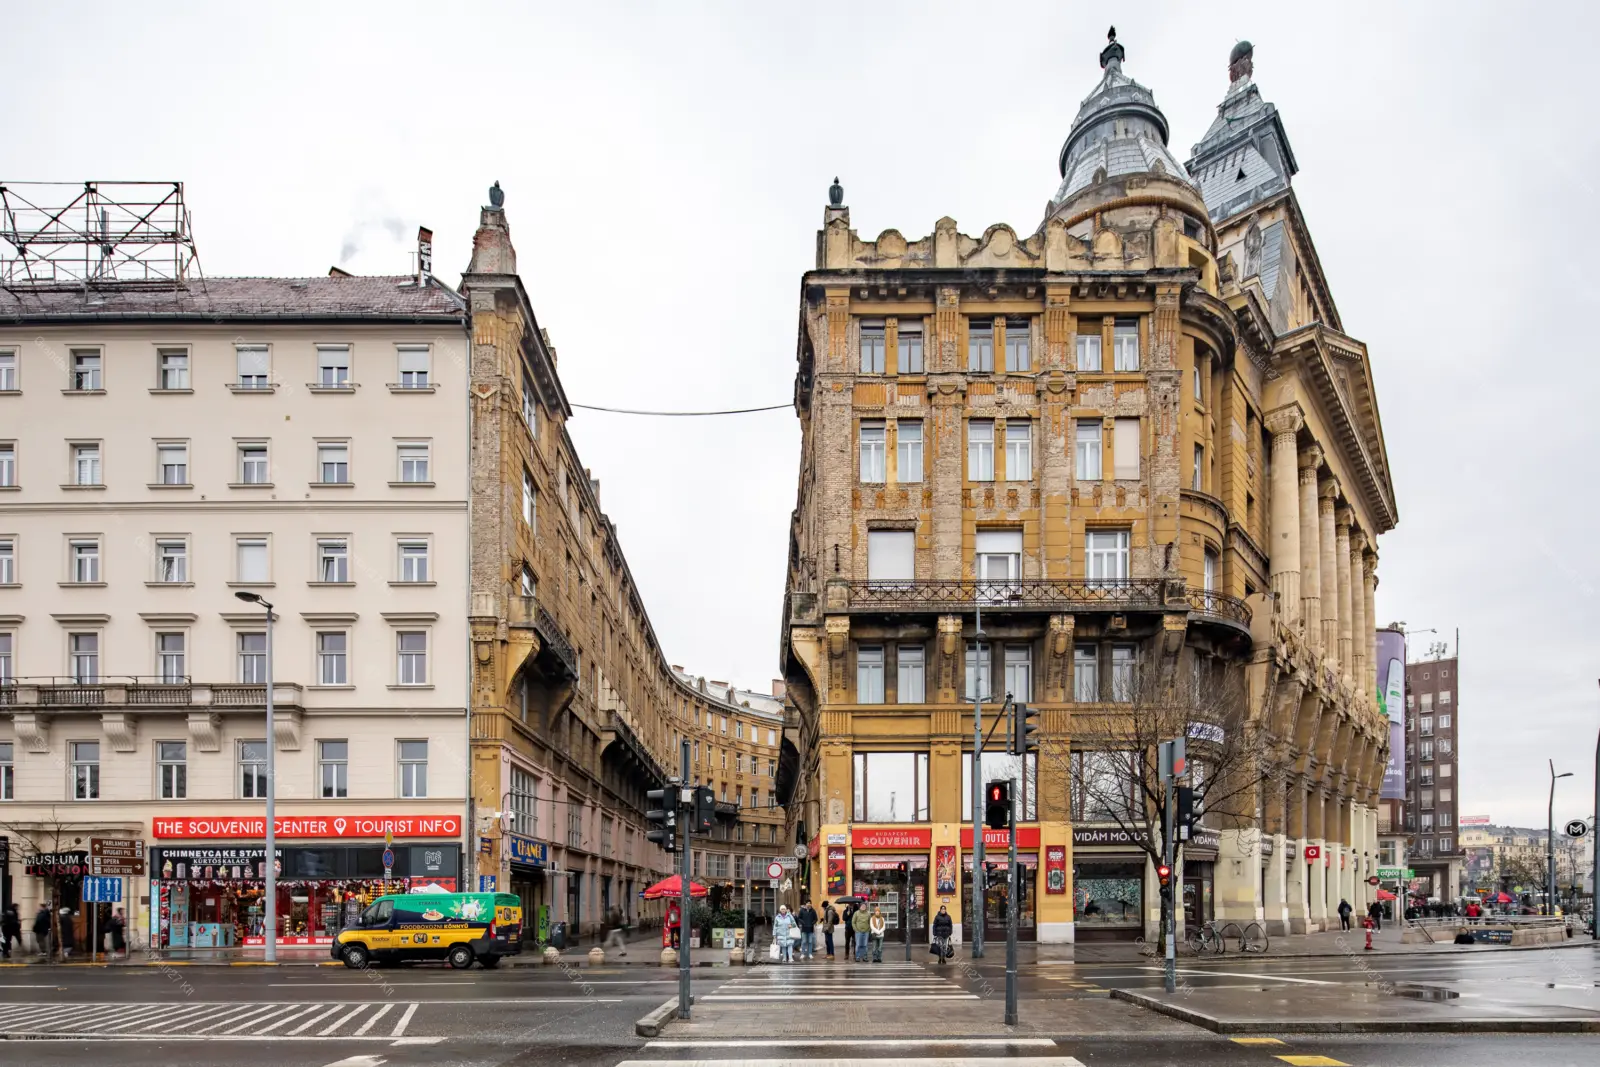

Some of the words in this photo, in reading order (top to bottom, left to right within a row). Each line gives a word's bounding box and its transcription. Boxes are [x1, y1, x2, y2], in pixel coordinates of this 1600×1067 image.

[156, 821, 183, 834] THE
[189, 821, 264, 834] SOUVENIR
[273, 821, 327, 834] CENTER
[354, 820, 413, 833] TOURIST
[419, 820, 457, 833] INFO
[1569, 823, 1583, 835] M
[862, 837, 921, 846] SOUVENIR
[1074, 831, 1108, 841] VIDÁM
[1193, 834, 1212, 846] VIDÁM
[517, 840, 543, 859] CHANGE
[24, 855, 79, 865] MUSEUM
